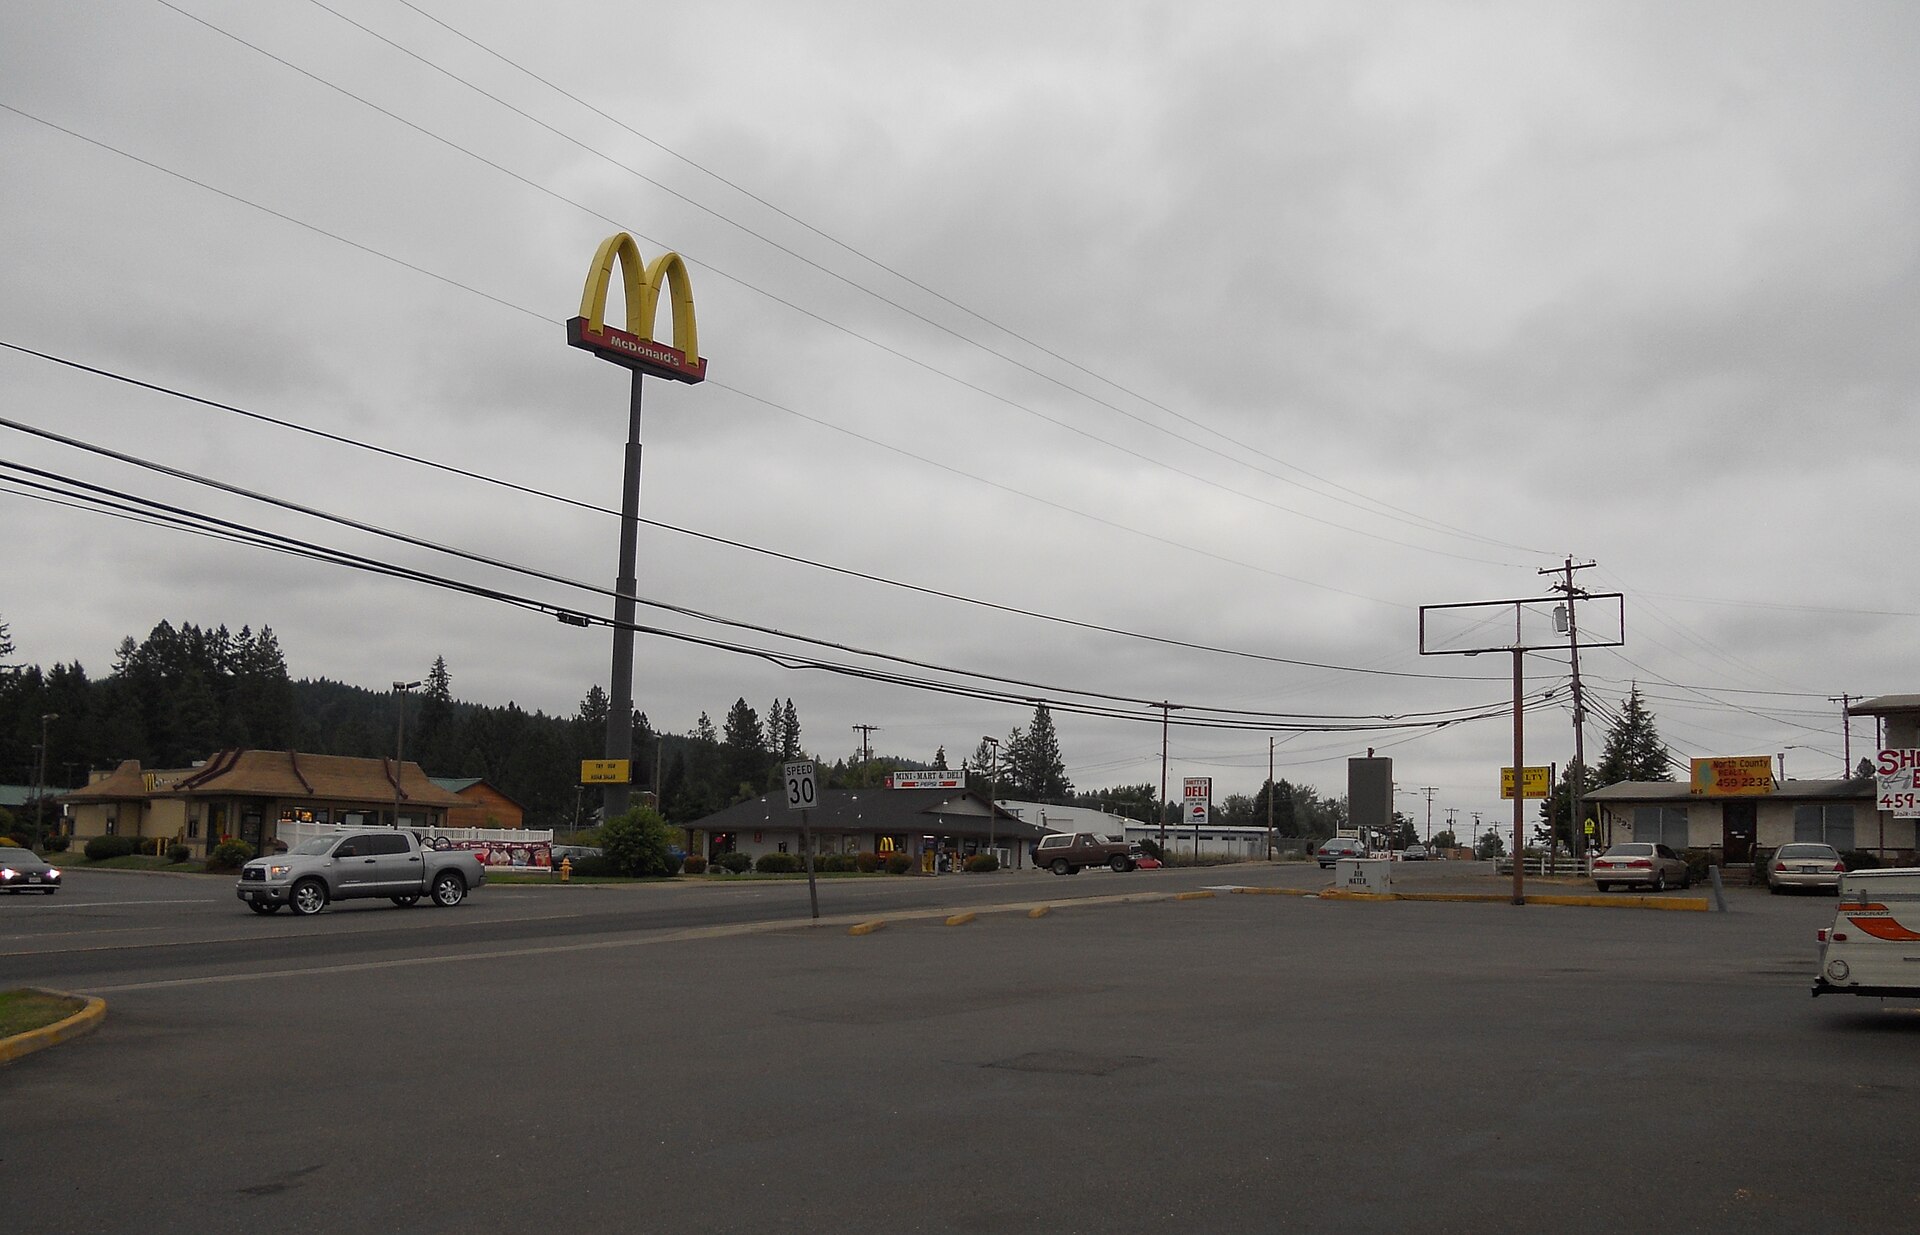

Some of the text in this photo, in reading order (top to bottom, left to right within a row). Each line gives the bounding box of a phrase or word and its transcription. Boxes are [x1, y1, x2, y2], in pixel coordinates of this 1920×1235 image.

[611, 336, 680, 366] McDonald's
[1713, 759, 1769, 769] North County
[786, 764, 813, 776] SPEED
[947, 771, 963, 779] DELI
[1718, 768, 1748, 777] REALTY
[1716, 777, 1770, 787] 459 2232
[789, 777, 814, 804] 30
[1185, 786, 1208, 797] DELI
[1354, 870, 1363, 878] AIR
